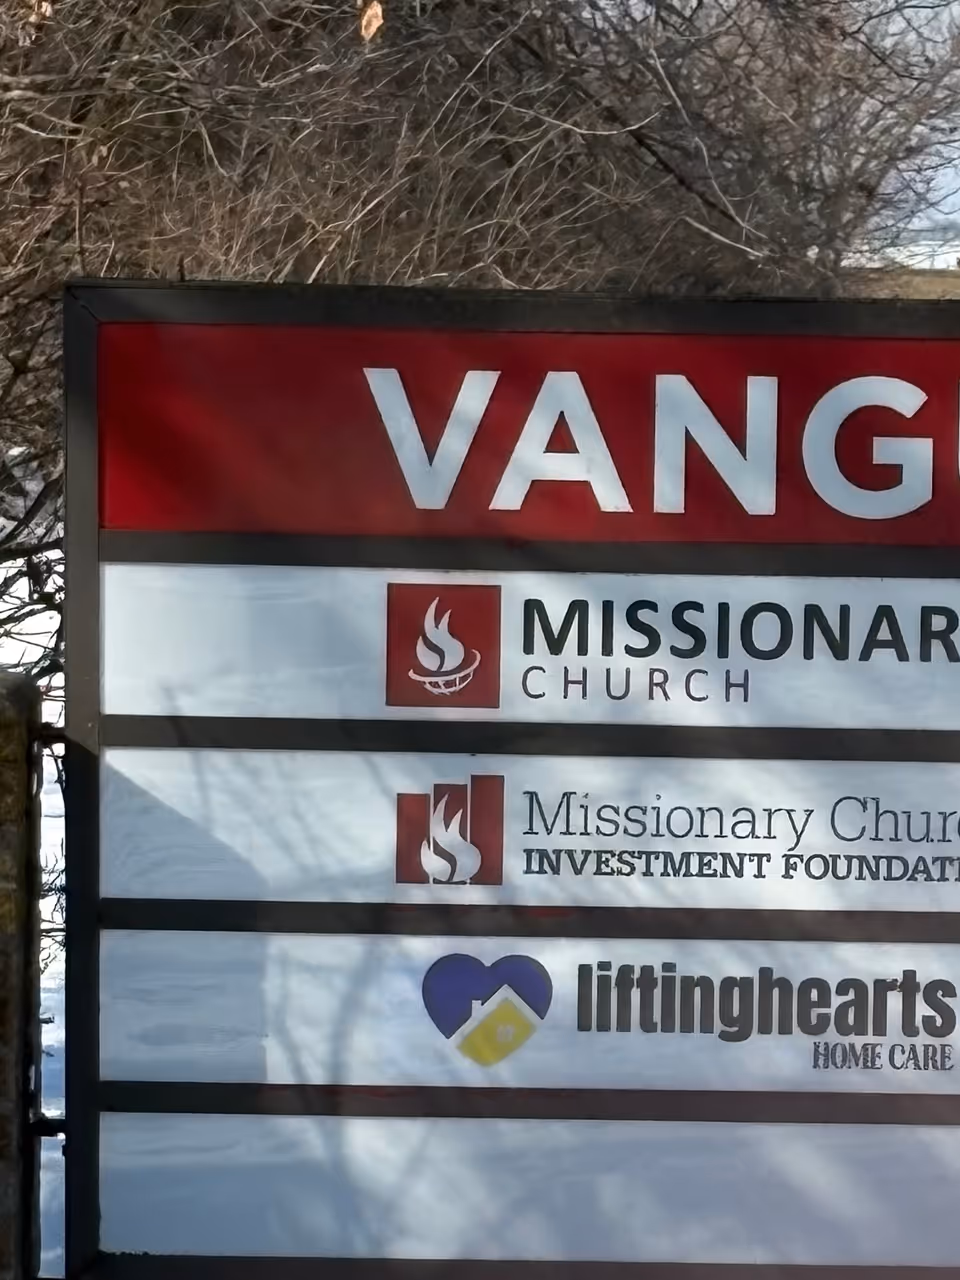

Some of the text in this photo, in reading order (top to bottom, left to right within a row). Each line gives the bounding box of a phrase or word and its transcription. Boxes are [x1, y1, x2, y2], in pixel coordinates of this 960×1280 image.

[522, 665, 750, 703] CHURCH
[522, 791, 814, 852] Missionary
[522, 848, 771, 879] INVESTMENT
[577, 961, 958, 1042] liftinghearts
[812, 1041, 955, 1071] HOME CARE
